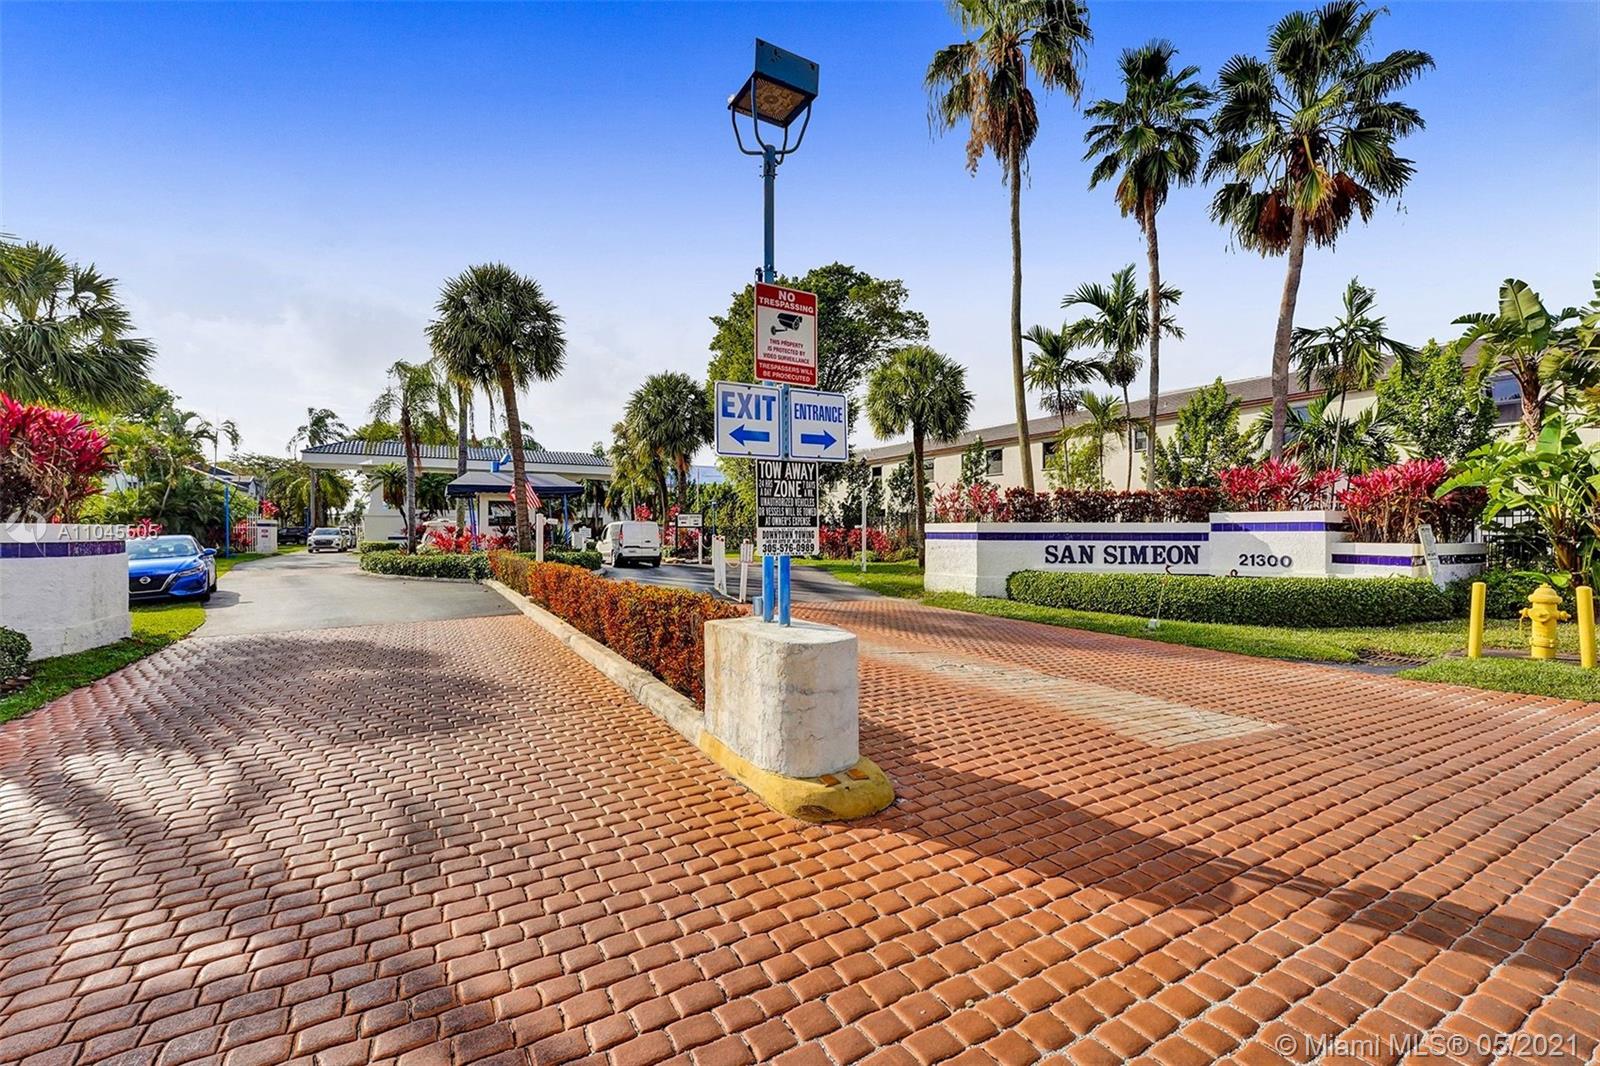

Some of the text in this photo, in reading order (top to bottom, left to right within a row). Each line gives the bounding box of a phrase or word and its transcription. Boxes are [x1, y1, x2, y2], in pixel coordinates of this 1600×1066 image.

[778, 290, 796, 302] NO
[758, 296, 814, 314] TRESPASSING
[781, 340, 804, 348] PROPERTY
[773, 346, 799, 356] PROTECTED
[763, 352, 810, 364] VIDEO SURVEILLANCE
[758, 362, 800, 374] TRESPASSERS
[771, 371, 811, 382] PROSECUTED
[721, 390, 777, 422] EXIT
[794, 402, 843, 423] ENTRANCE
[758, 461, 815, 480] TOW AWAY
[773, 480, 802, 498] ZONE
[765, 506, 785, 516] VESSELS
[785, 507, 796, 516] WILL
[796, 507, 803, 516] BE
[762, 530, 815, 539] DOWNTOWN TOWING
[762, 543, 815, 553] 305-576-0989
[1044, 544, 1201, 565] SAN SIMEON
[1238, 553, 1293, 568] 21300
